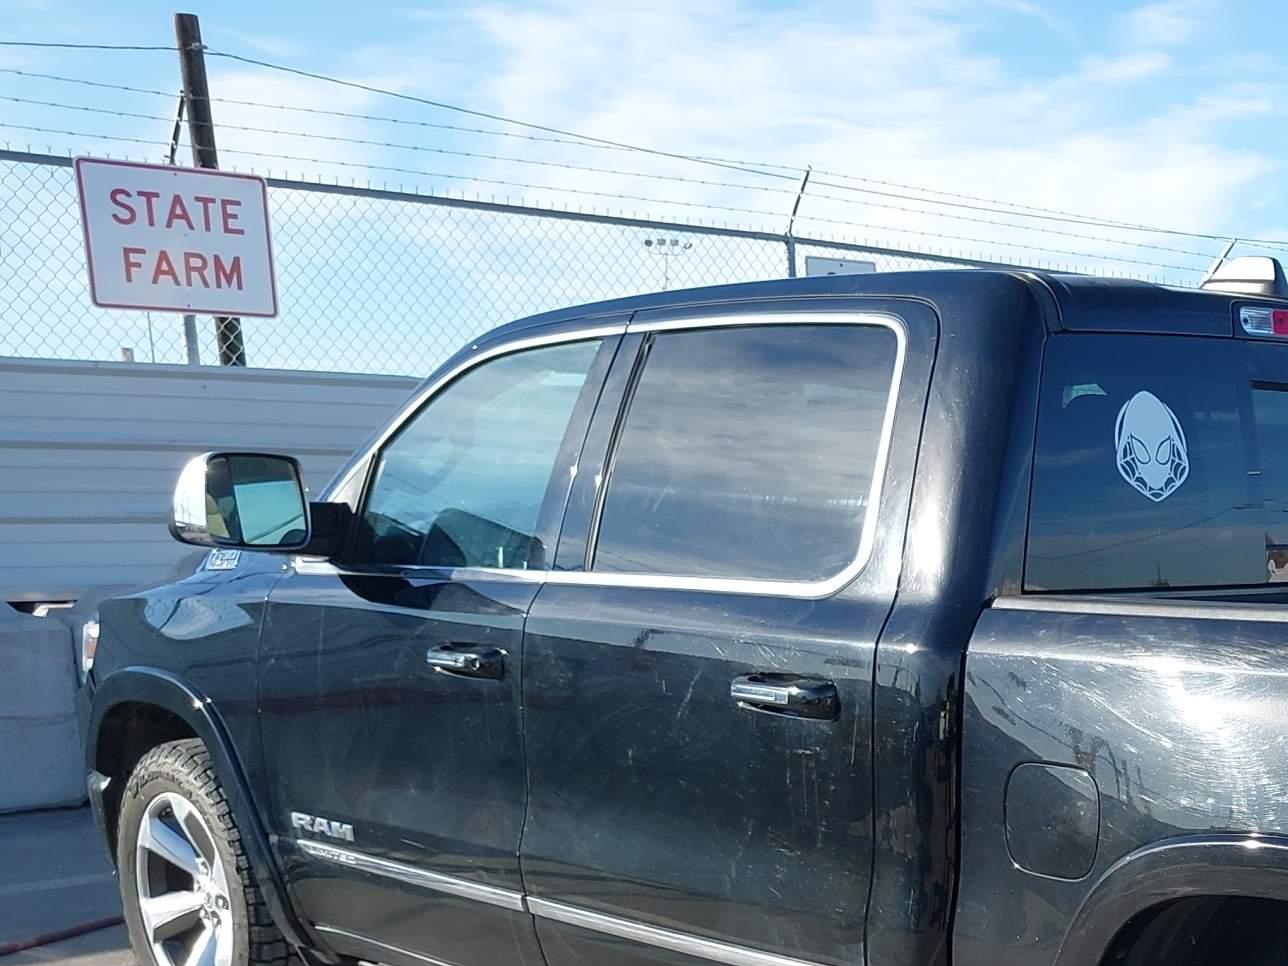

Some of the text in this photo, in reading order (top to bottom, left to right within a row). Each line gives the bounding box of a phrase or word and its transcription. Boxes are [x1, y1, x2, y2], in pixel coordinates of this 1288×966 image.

[109, 187, 246, 236] STATE
[122, 246, 244, 291] FARM
[291, 811, 355, 842] RAM
